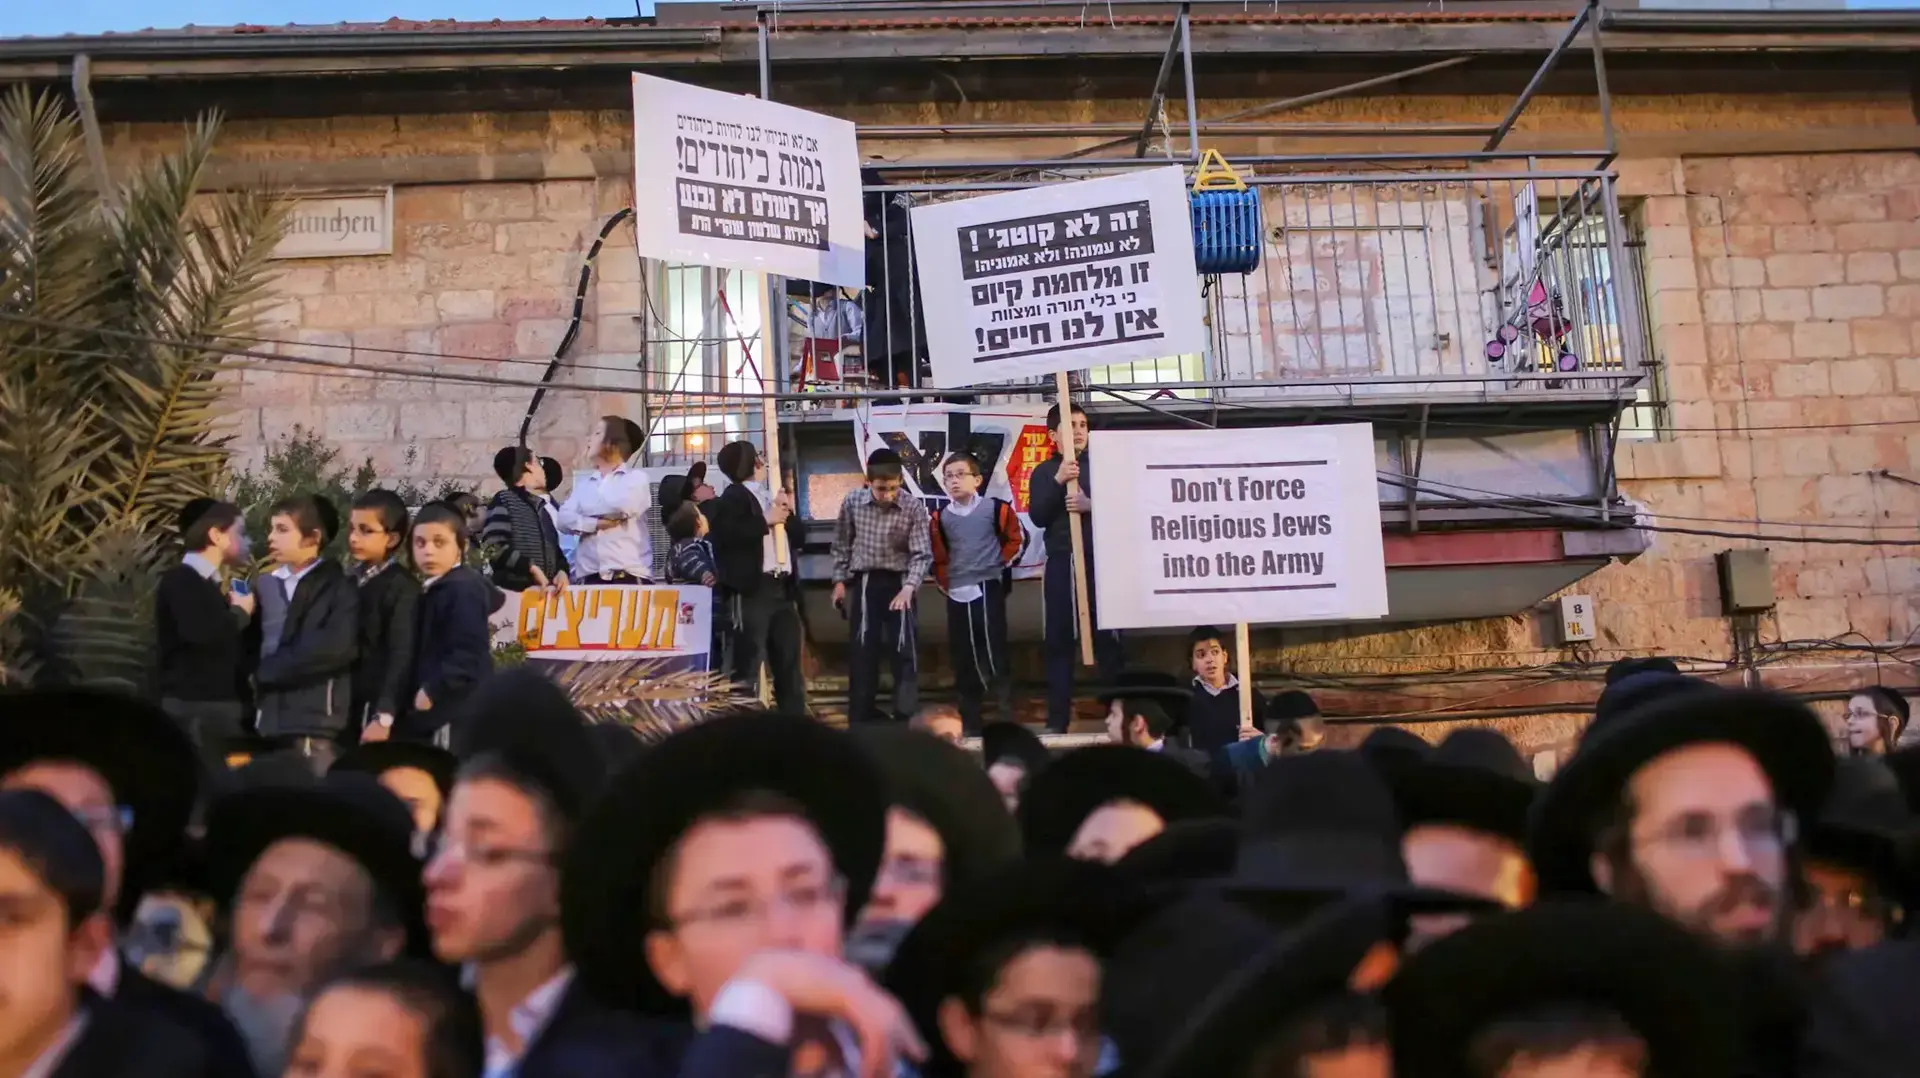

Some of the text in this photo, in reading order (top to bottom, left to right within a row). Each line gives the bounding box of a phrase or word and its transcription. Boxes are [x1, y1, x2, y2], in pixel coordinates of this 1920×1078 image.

[677, 114, 713, 135] כיהודים
[716, 121, 742, 139] לחיות
[746, 125, 761, 142] לנו
[791, 133, 803, 150] לא
[806, 137, 819, 152] אם
[676, 135, 826, 192] נמות כיהודים!
[679, 183, 827, 227] אך לעולם לא נכנע
[691, 214, 712, 233] הדת
[714, 217, 745, 237] עוקרי
[747, 221, 782, 239] שלטון
[1064, 212, 1100, 239] לא
[1110, 209, 1140, 230] זה
[975, 236, 1140, 273] לא עמונה! ולא אמוניה!
[971, 261, 1150, 307] זו מלחמת קיום
[991, 291, 1137, 323] כי בלי תורה ומצוות
[975, 307, 1159, 352] אין לנו חיים!
[1171, 476, 1305, 503] Don't Force
[1151, 512, 1332, 543] Religious Jews
[1163, 550, 1324, 578] into the Army
[1574, 604, 1583, 614] 8
